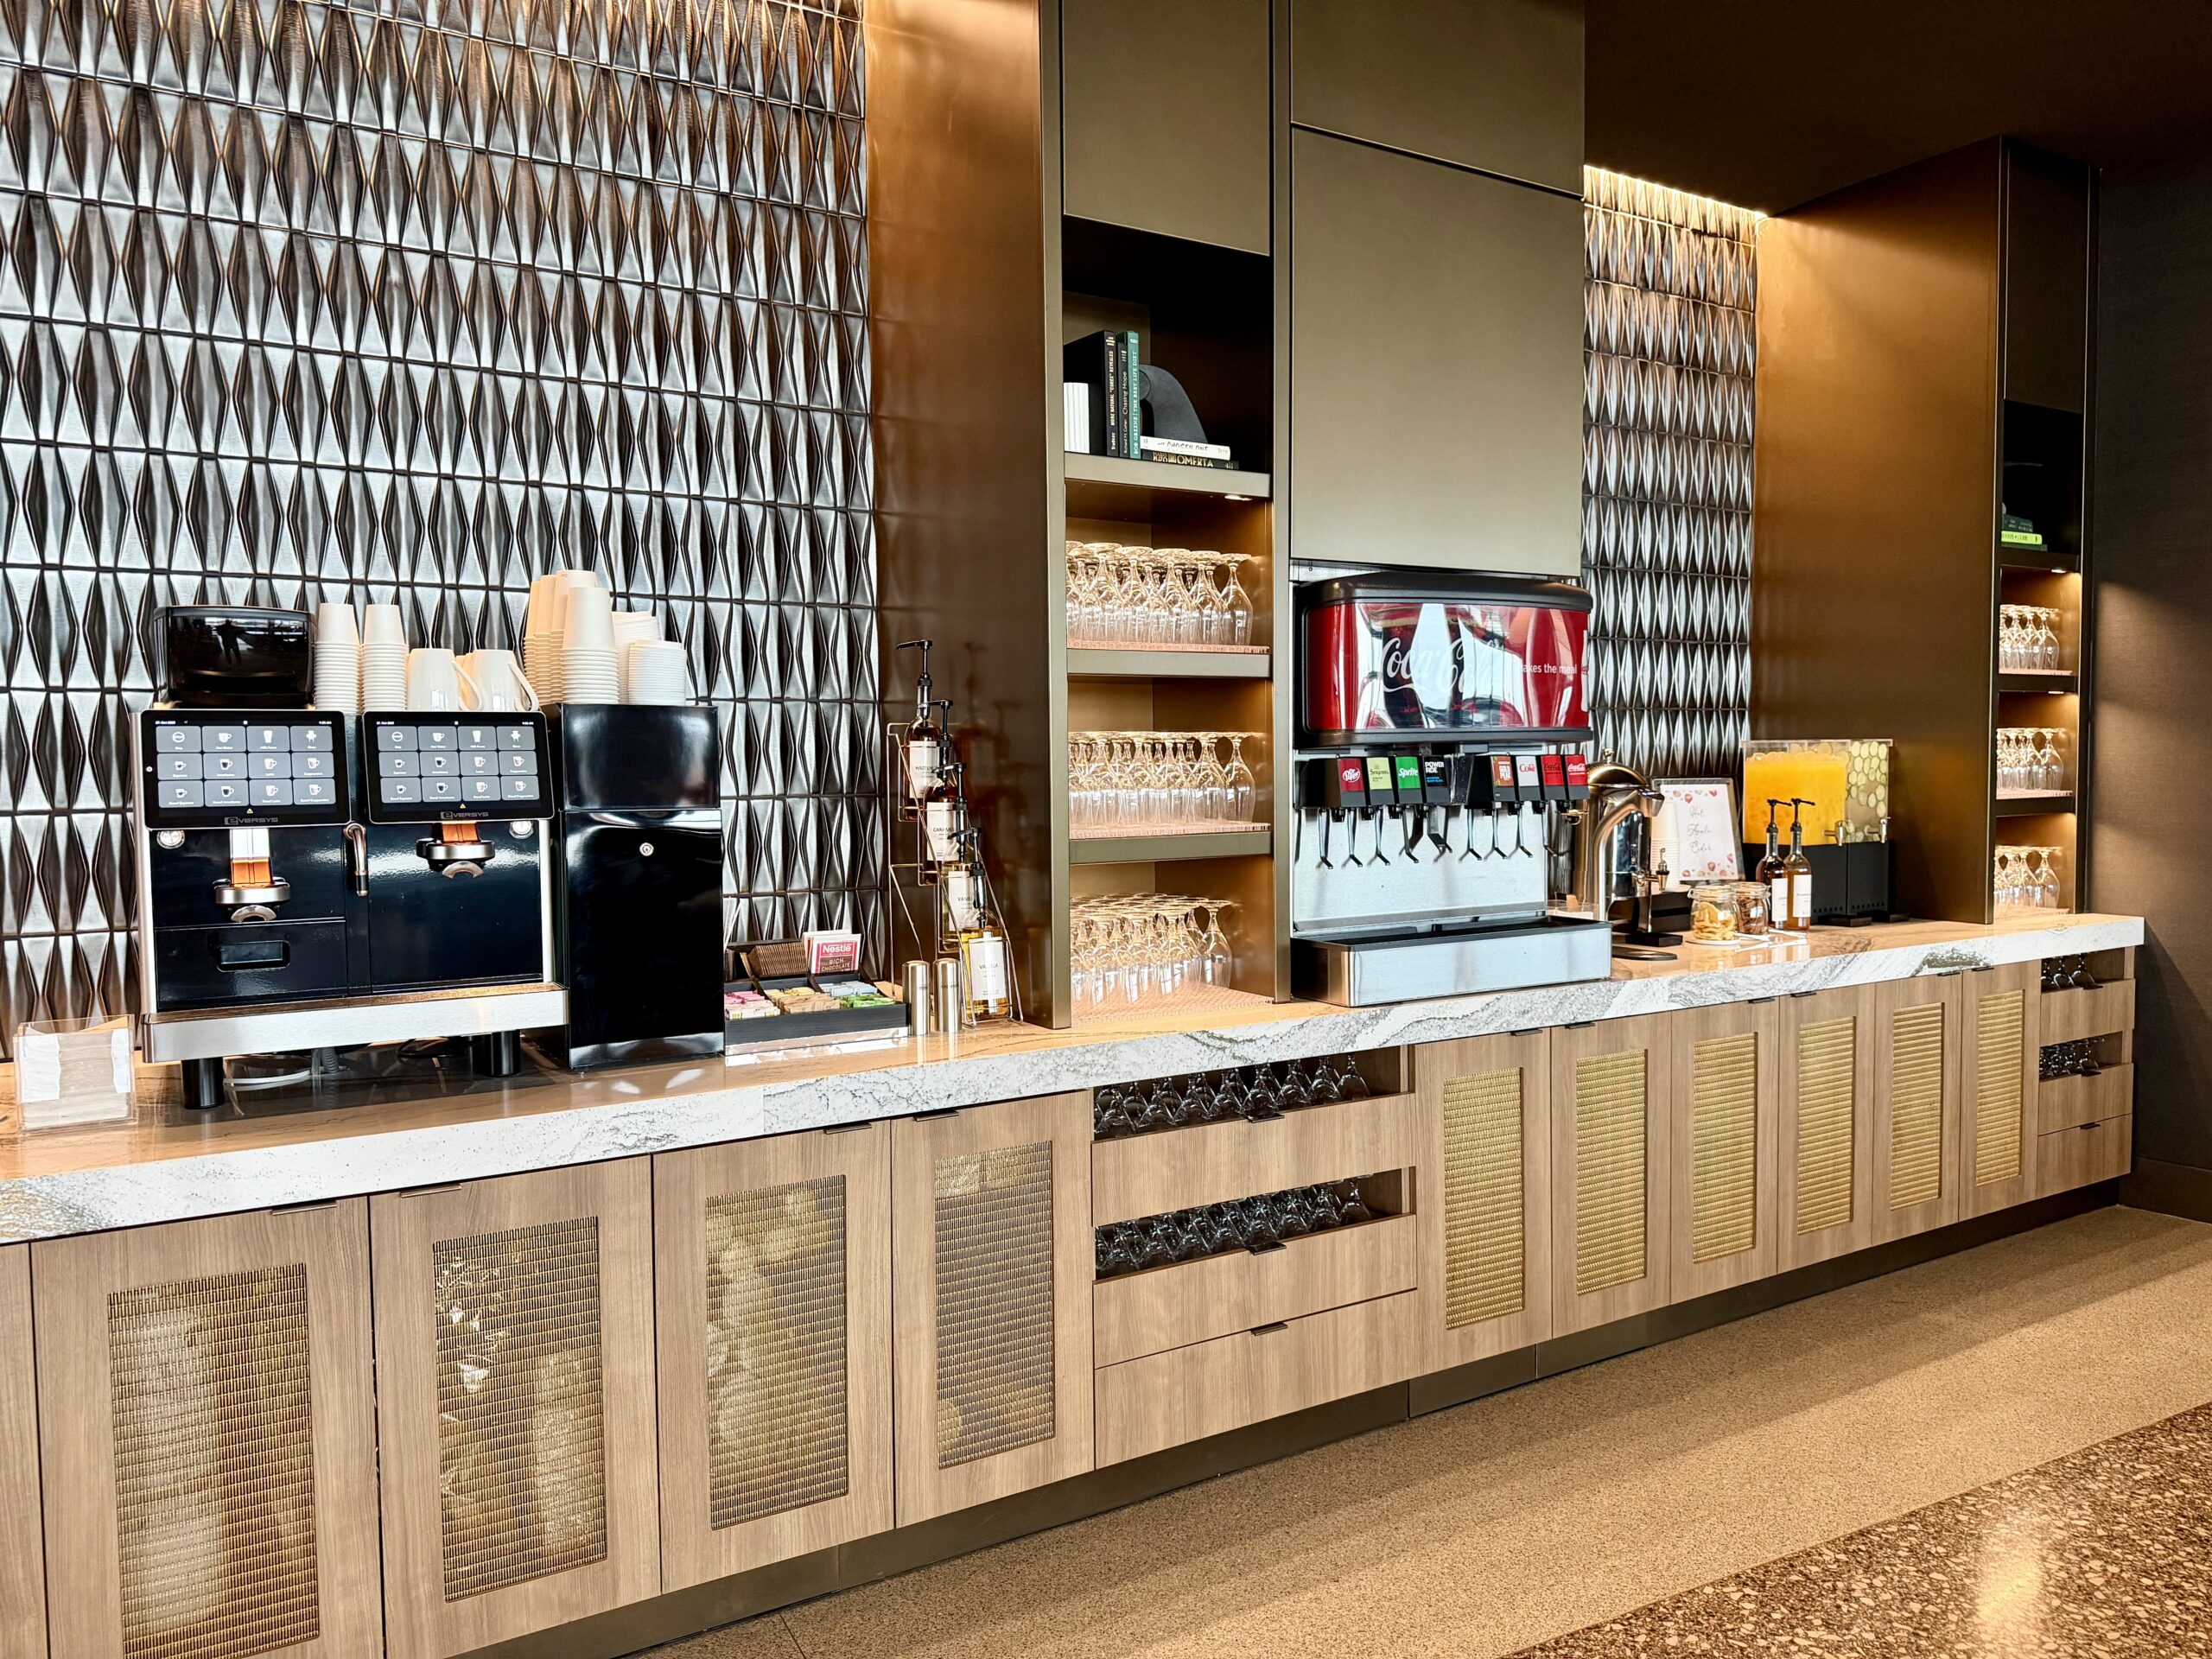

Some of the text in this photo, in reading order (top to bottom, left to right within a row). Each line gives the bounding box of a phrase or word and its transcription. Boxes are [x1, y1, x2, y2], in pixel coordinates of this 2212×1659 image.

[1522, 663, 1578, 674] akes the meal
[1398, 767, 1418, 778] Sprite
[1519, 764, 1536, 772] Coke
[829, 957, 844, 966] RICH
[821, 962, 851, 972] CHOCOLATE
